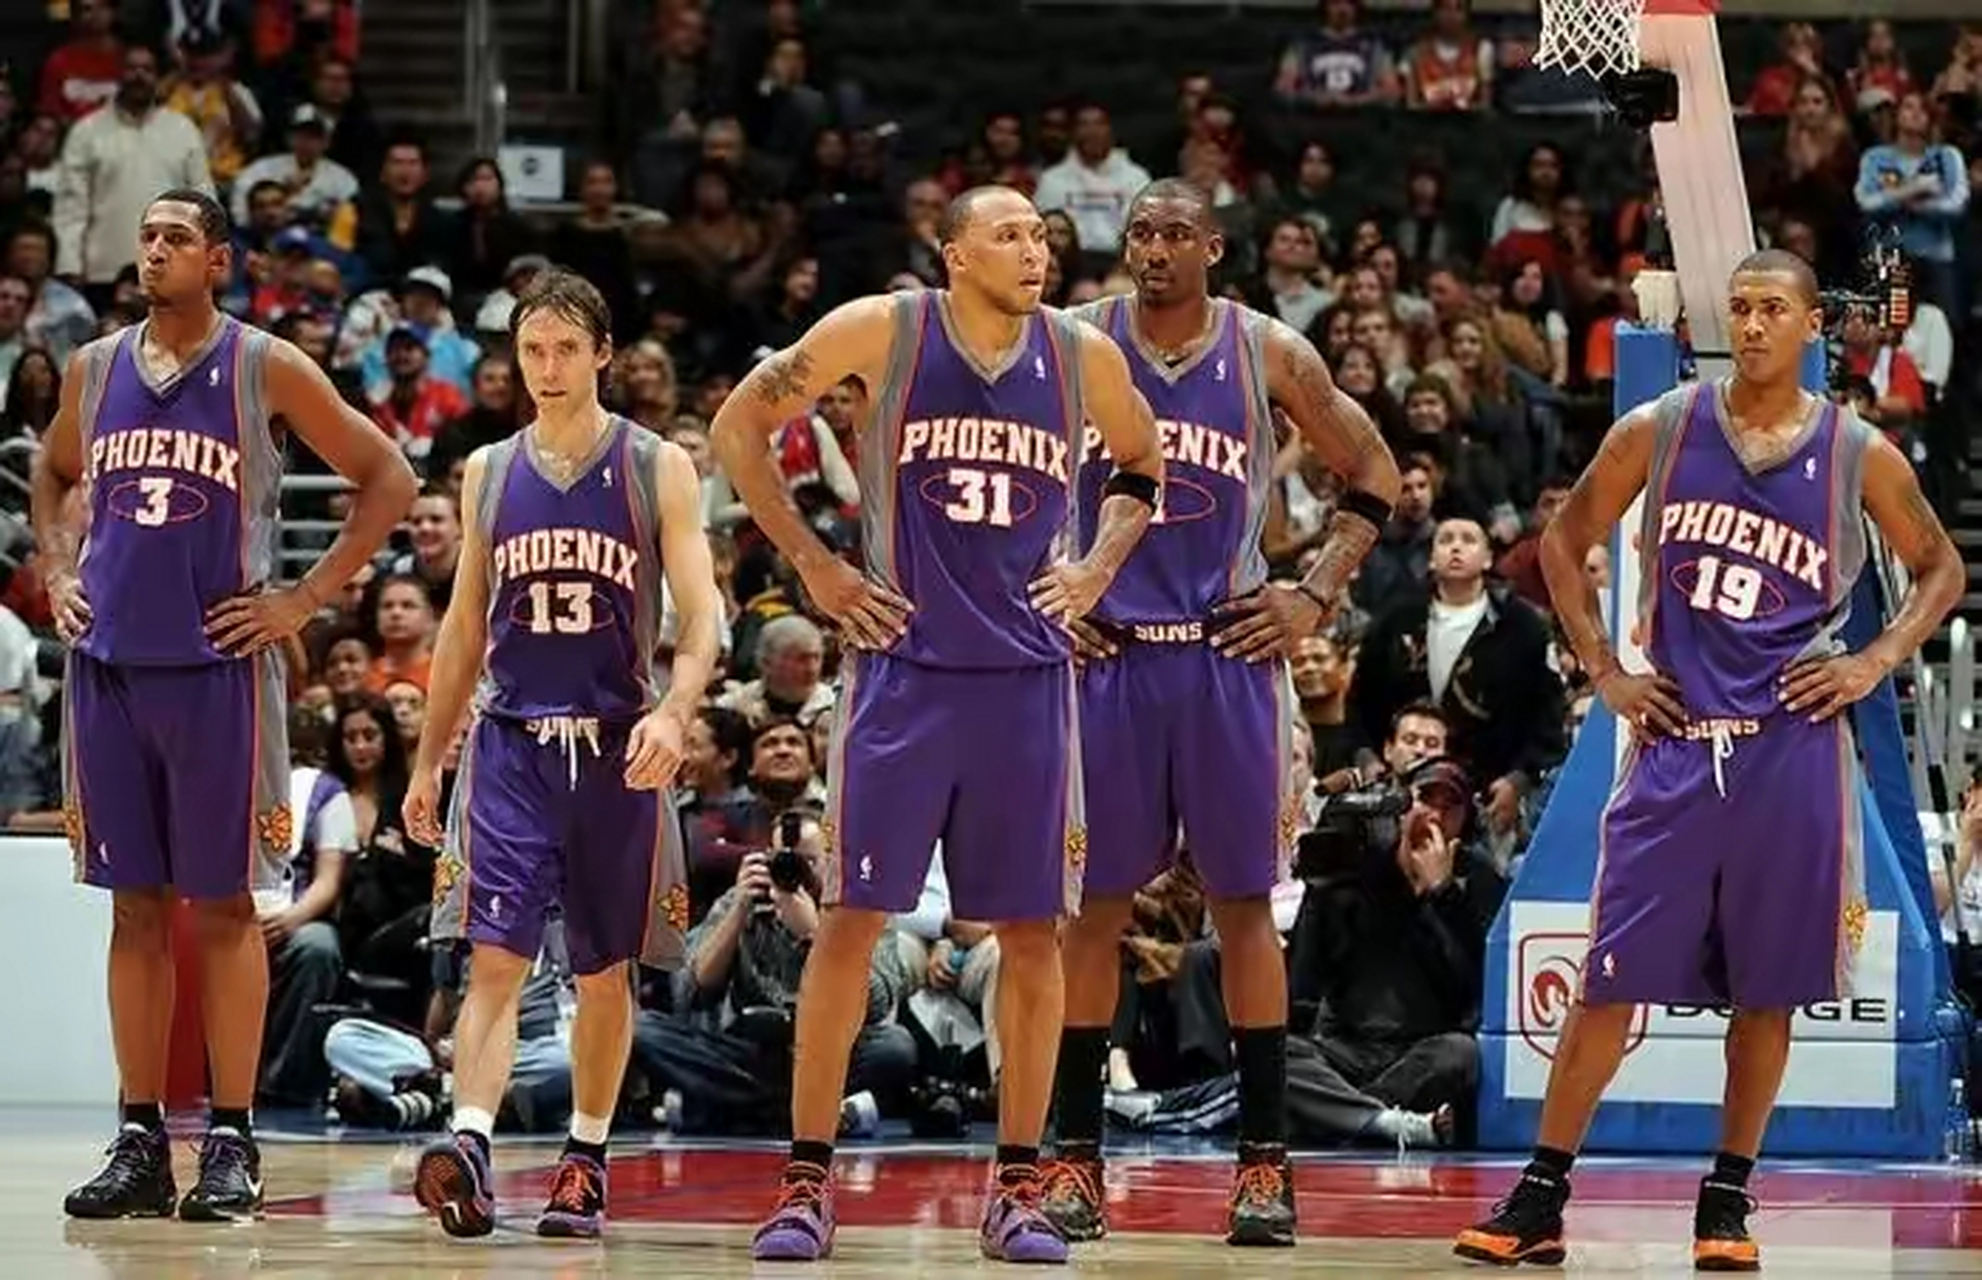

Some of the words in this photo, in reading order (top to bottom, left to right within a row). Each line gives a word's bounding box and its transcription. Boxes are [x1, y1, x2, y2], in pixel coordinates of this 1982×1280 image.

[91, 428, 240, 491] PHOENIX
[899, 418, 1068, 484] PHOENIX
[1079, 419, 1247, 484] PENIX
[135, 477, 174, 527] 3
[945, 467, 1012, 527] 31
[494, 528, 638, 592] PHOENIX
[1659, 501, 1828, 591] PHOENIX
[529, 582, 593, 634] 13
[1689, 555, 1763, 620] 19
[1134, 622, 1203, 642] SUNS
[1667, 999, 1887, 1022] DGE
